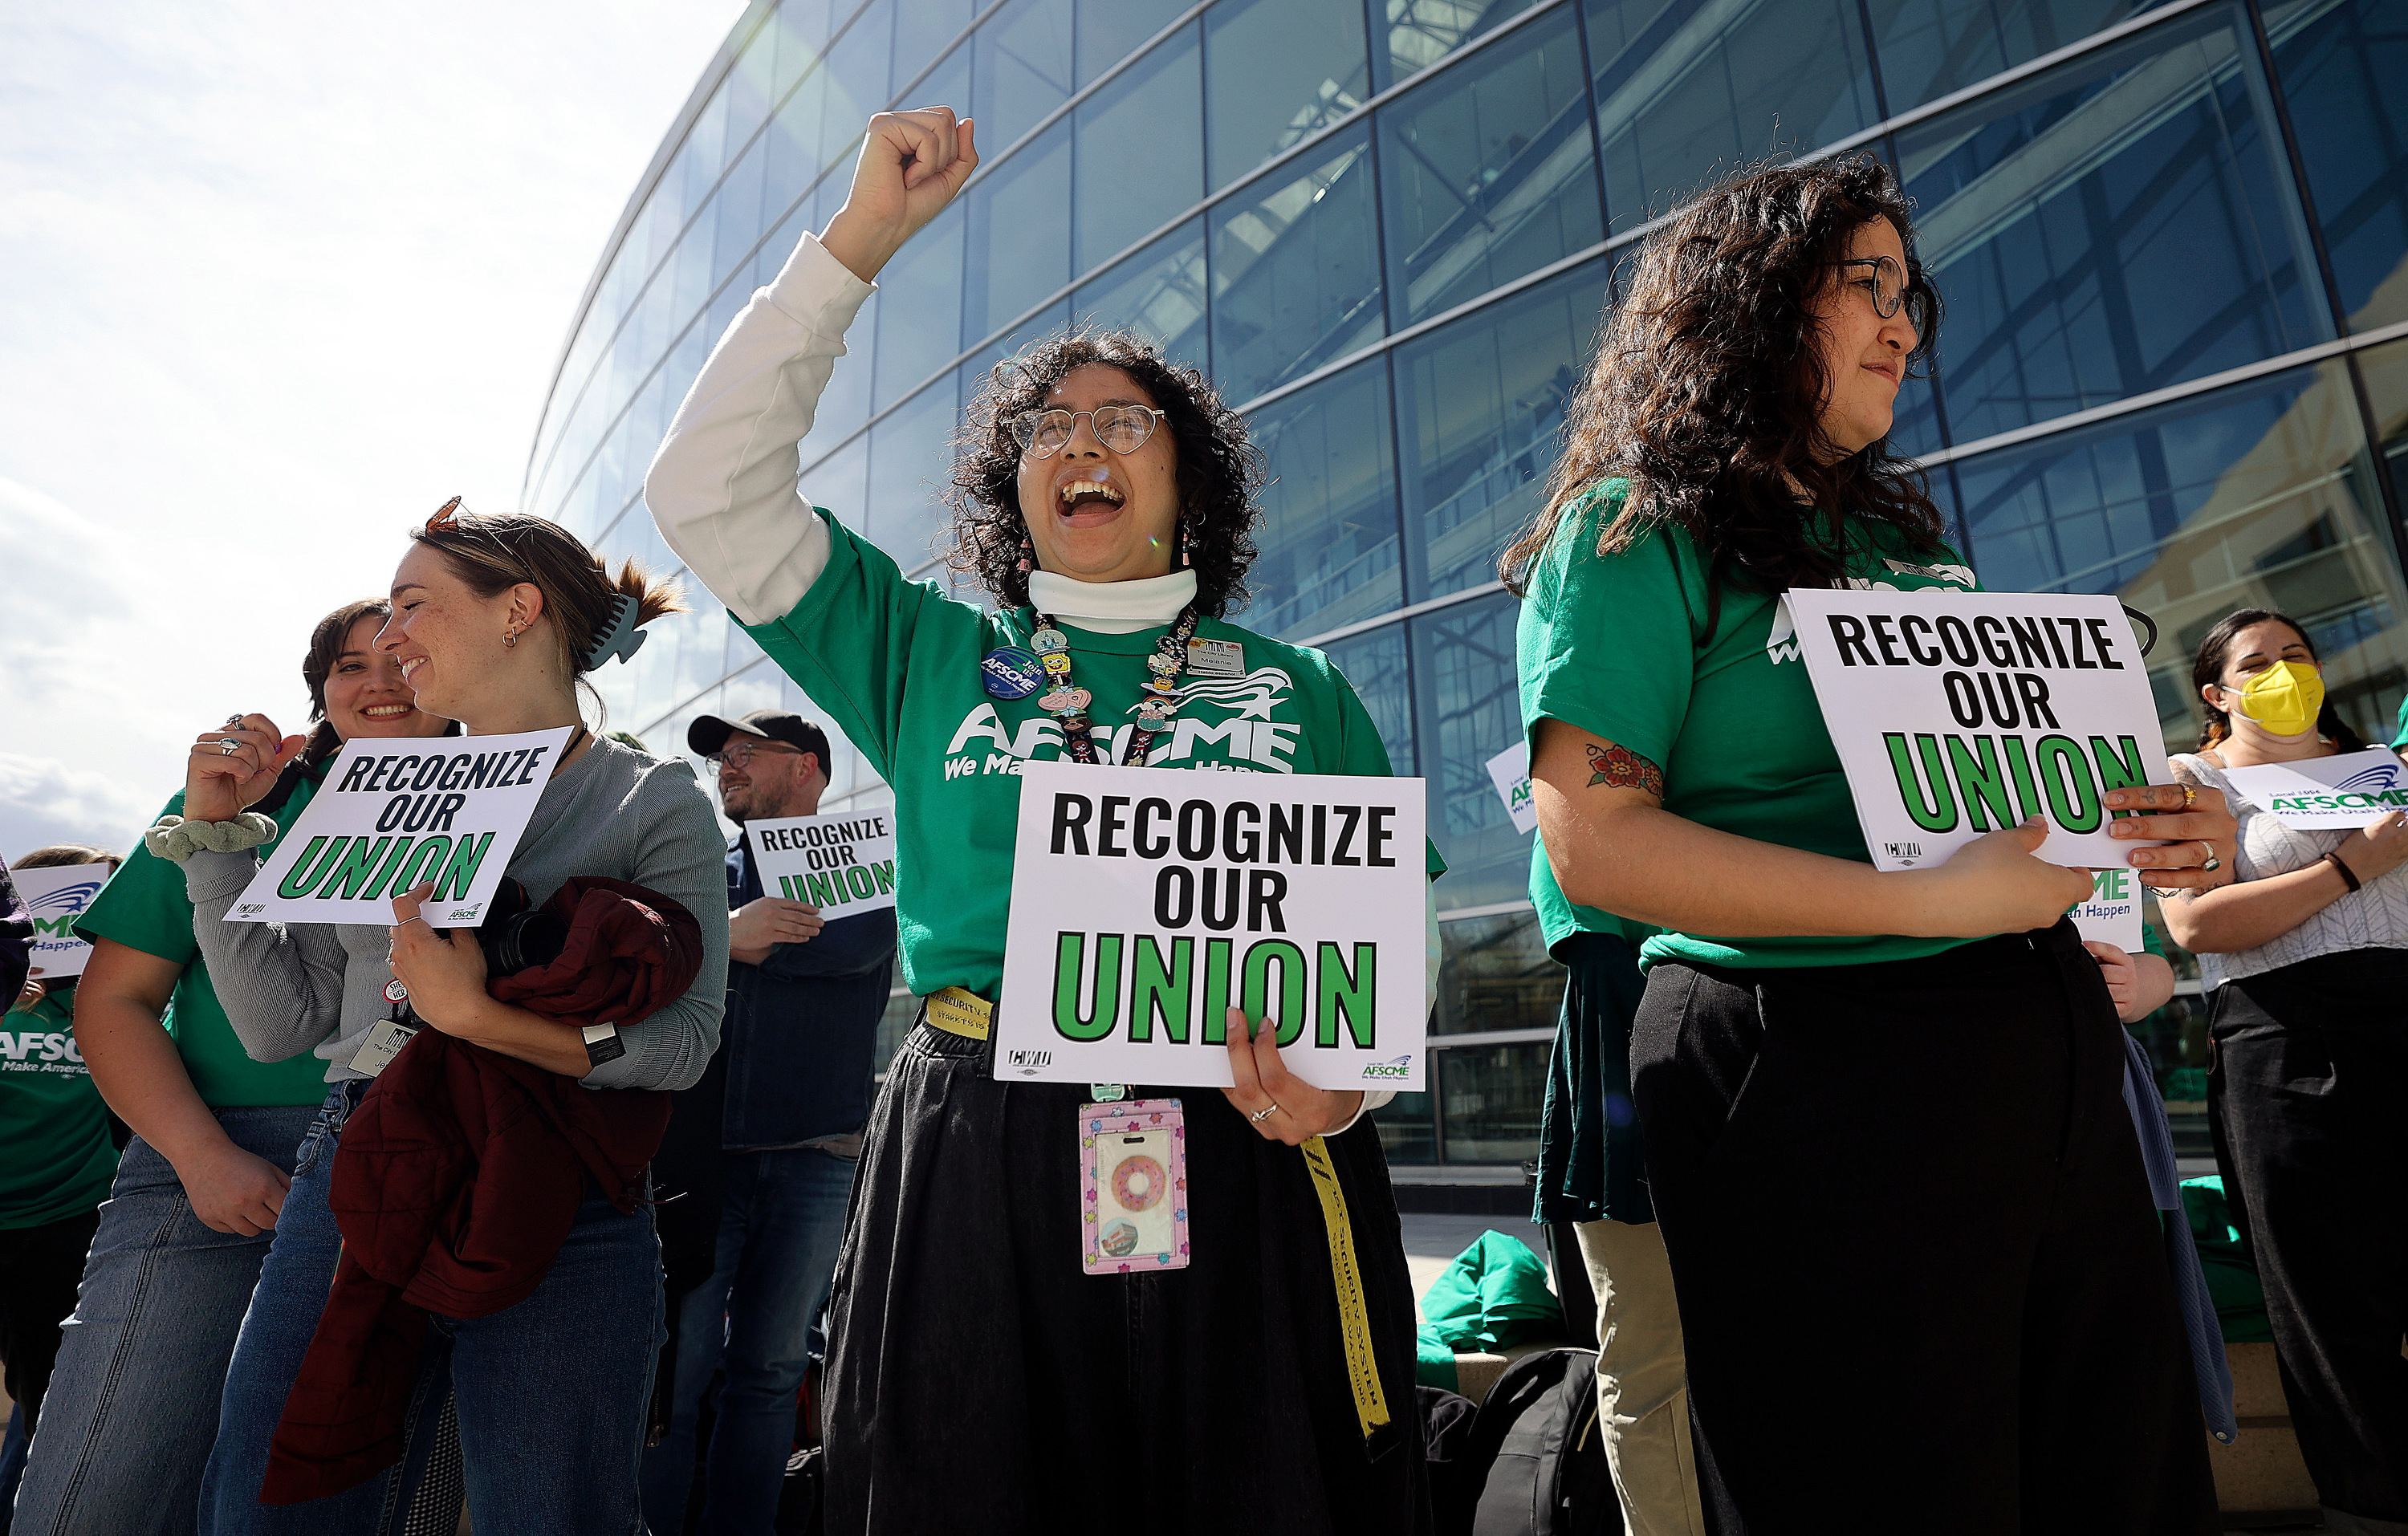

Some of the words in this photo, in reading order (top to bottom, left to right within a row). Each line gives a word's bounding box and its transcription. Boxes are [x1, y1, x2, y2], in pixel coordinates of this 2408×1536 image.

[1767, 642, 1802, 665] W
[1826, 614, 2125, 671] RECOGNIZE
[981, 658, 1037, 691] AFSCME
[1023, 660, 1043, 676] Join
[1023, 668, 1035, 678] us
[1201, 658, 1232, 666] Melanie
[1942, 670, 2061, 729] OUR
[336, 746, 549, 792] RECOGNIZE
[945, 755, 978, 782] We
[983, 753, 1024, 776] Ma
[1511, 779, 1533, 807] AF
[1881, 731, 2159, 835] UNION
[375, 793, 467, 833] OUR
[1513, 805, 1524, 815] We
[2272, 788, 2408, 810] AFSCME
[759, 817, 888, 851] RECOGNIZE
[1050, 792, 1397, 867] RECOGNIZE
[276, 831, 497, 903] UNION
[805, 845, 857, 871] OUR
[779, 859, 895, 908] UNION
[2091, 868, 2129, 901] ME
[1153, 865, 1287, 933] OUR
[2086, 904, 2130, 920] Happen
[449, 910, 479, 918] AFSCME
[32, 940, 87, 952] Happe
[389, 981, 405, 992] SHE
[393, 989, 406, 1000] HER
[1051, 930, 1377, 1050] UNION
[940, 994, 981, 1016] SECURITY
[0, 1031, 85, 1063] AFSC
[373, 1043, 383, 1051] The
[383, 1047, 393, 1056] City
[2, 1060, 40, 1072] Make
[40, 1062, 90, 1075] Americ
[375, 1060, 386, 1069] Je
[1362, 1066, 1410, 1076] AFSCME
[1340, 1227, 1361, 1320] SECURITY
[1357, 1325, 1378, 1406] SYSTEM
[1348, 1324, 1366, 1406] WATCHING
